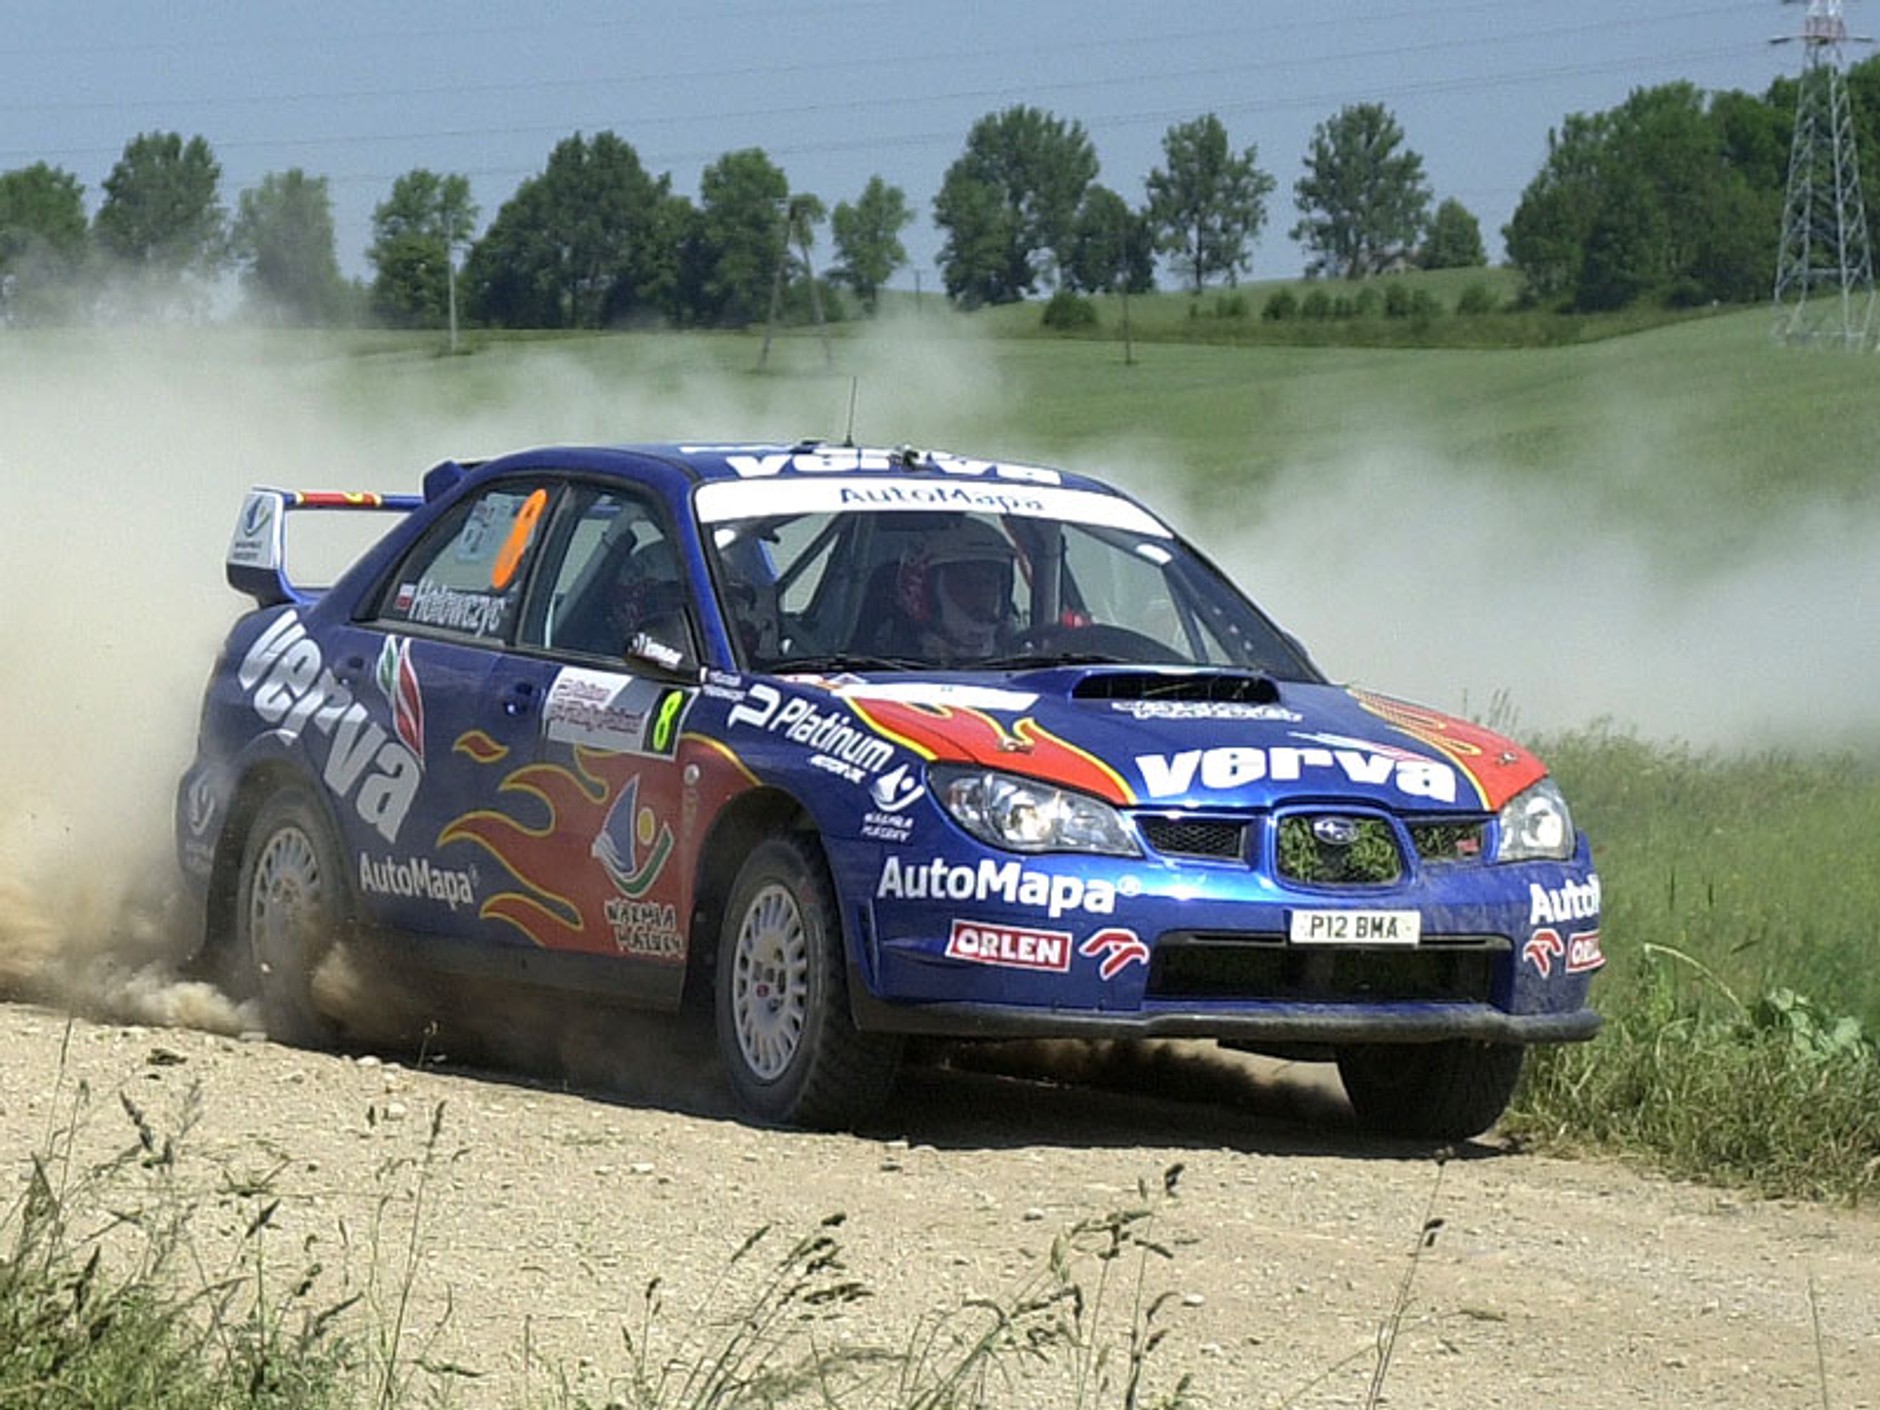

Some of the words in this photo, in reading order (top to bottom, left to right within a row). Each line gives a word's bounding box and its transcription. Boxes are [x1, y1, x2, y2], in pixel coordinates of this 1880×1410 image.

[841, 486, 1044, 513] AutoMapa
[238, 609, 420, 845] verva
[653, 690, 683, 751] 8
[768, 698, 895, 772] Platinum
[1136, 746, 1456, 803] verva
[956, 928, 1062, 964] ORLEN
[1310, 915, 1348, 938] P12
[1355, 916, 1399, 939] BMA
